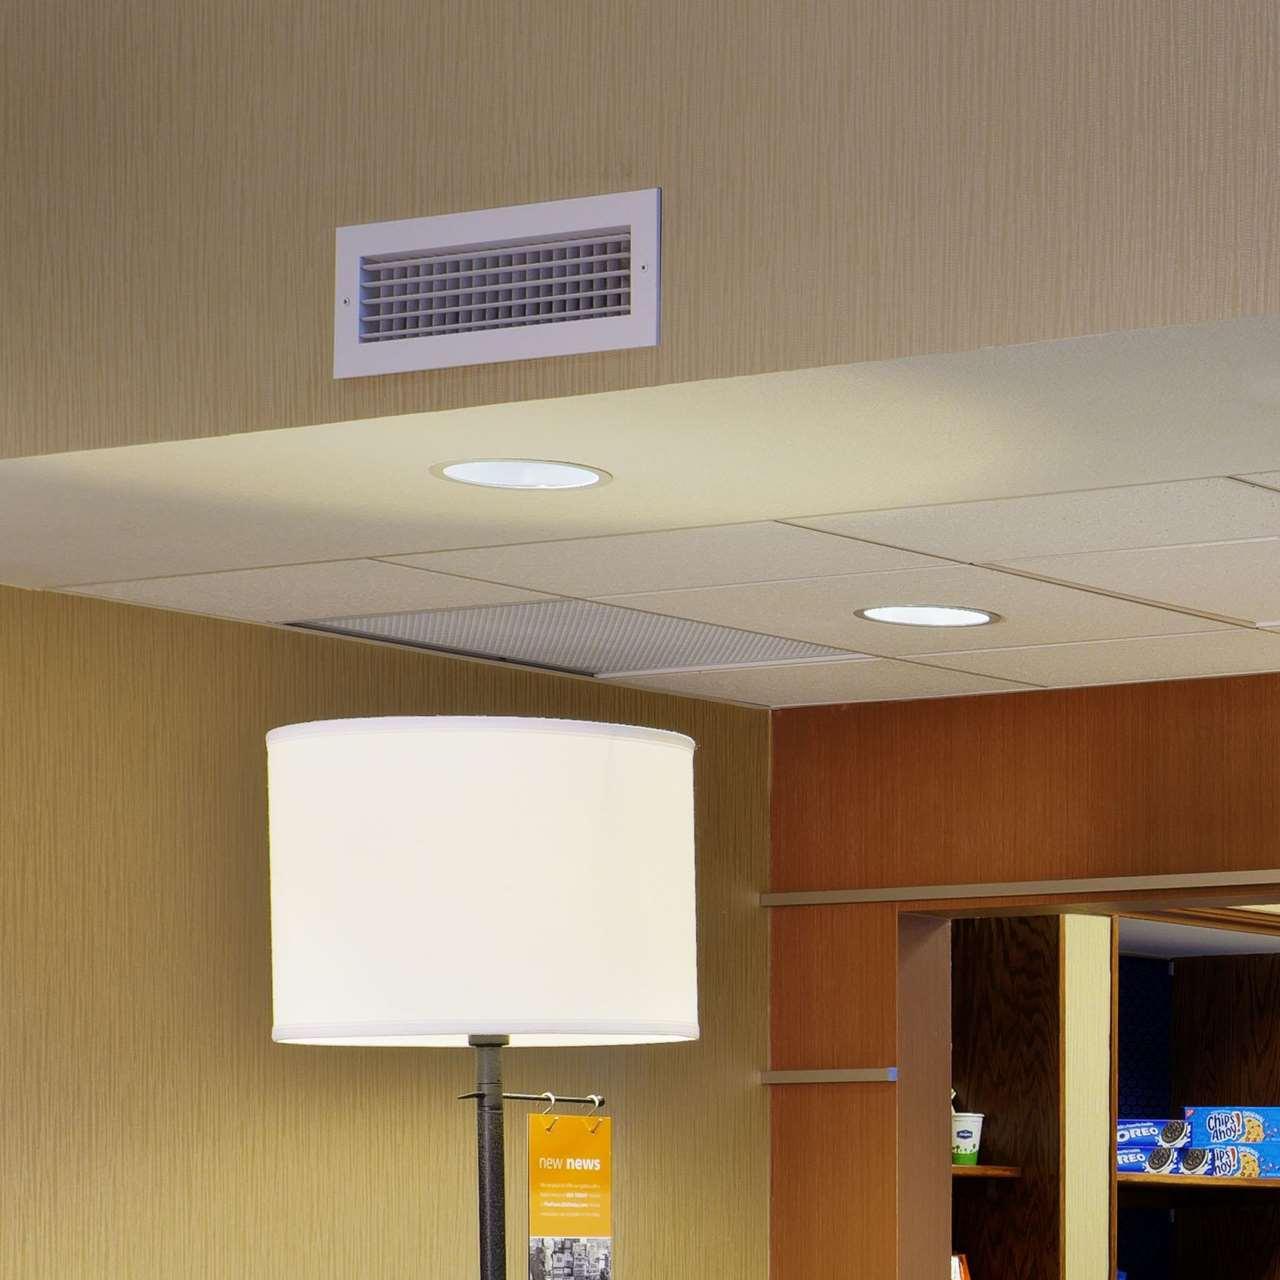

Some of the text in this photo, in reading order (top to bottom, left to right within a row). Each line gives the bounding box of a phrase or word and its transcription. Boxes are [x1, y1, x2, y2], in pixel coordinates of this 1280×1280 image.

[1207, 1111, 1235, 1131] Chips
[1117, 1127, 1159, 1143] OREO
[539, 1156, 601, 1171] new news
[1117, 1153, 1146, 1164] REO
